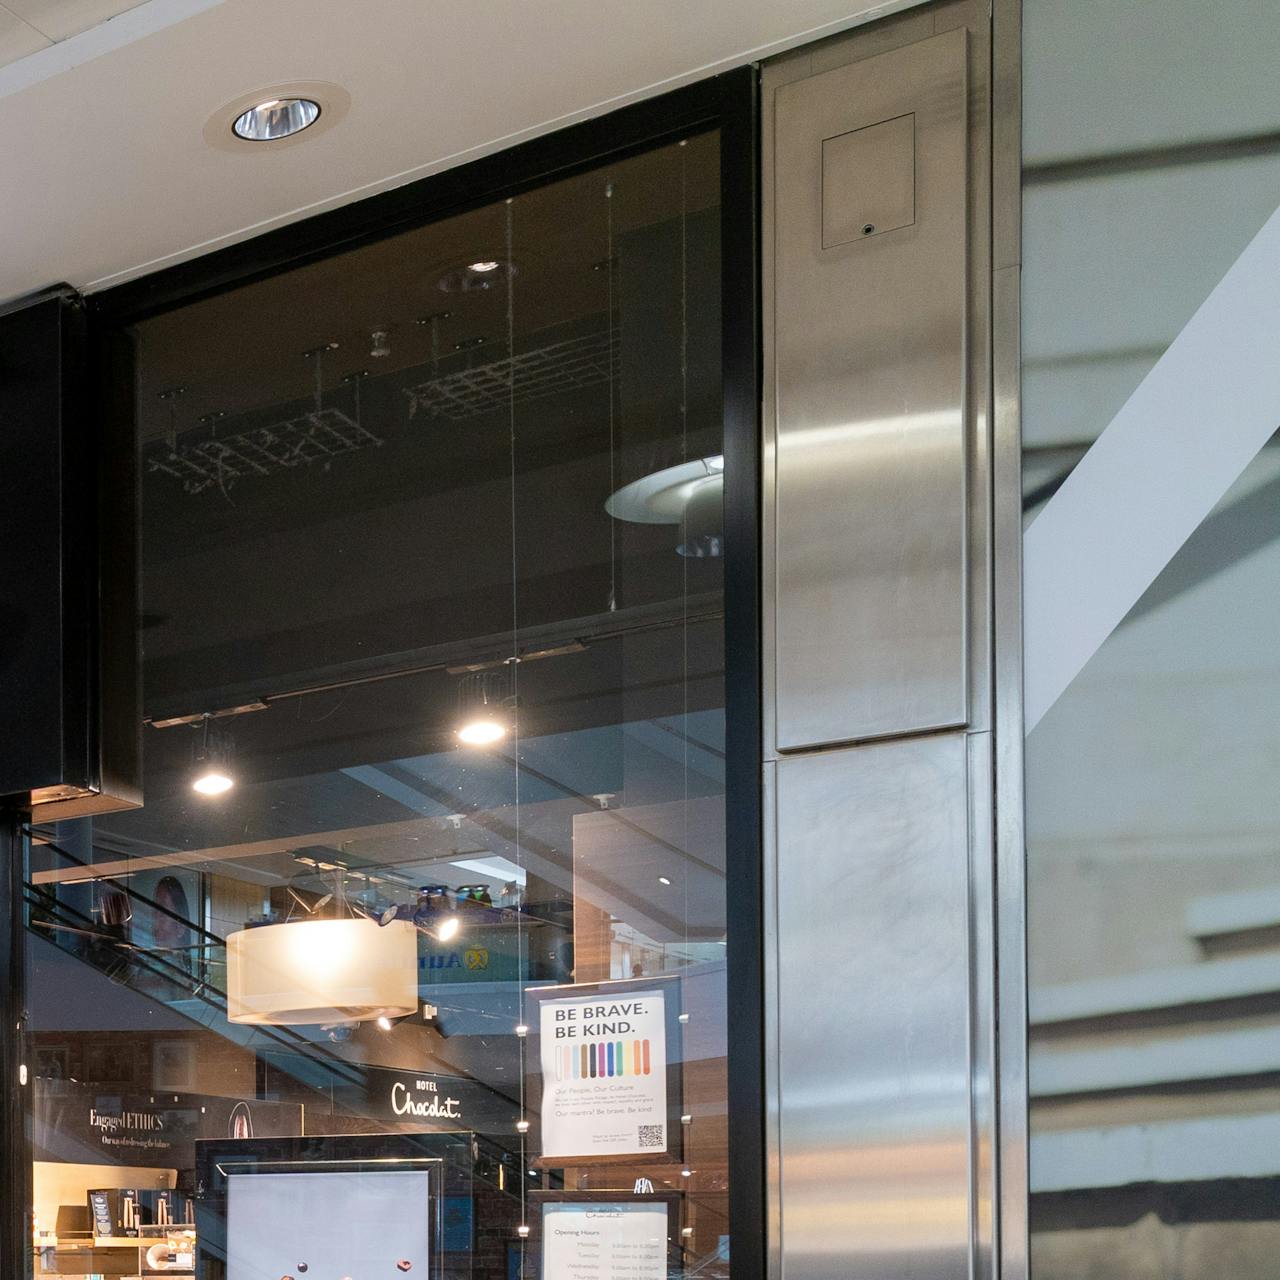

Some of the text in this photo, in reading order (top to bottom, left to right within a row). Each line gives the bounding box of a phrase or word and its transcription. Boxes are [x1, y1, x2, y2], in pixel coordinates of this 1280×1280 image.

[555, 1003, 648, 1021] BE BRAVE.
[555, 1021, 635, 1038] BE KIND.
[416, 1080, 437, 1092] HOTEL
[127, 1112, 163, 1130] ETHICS
